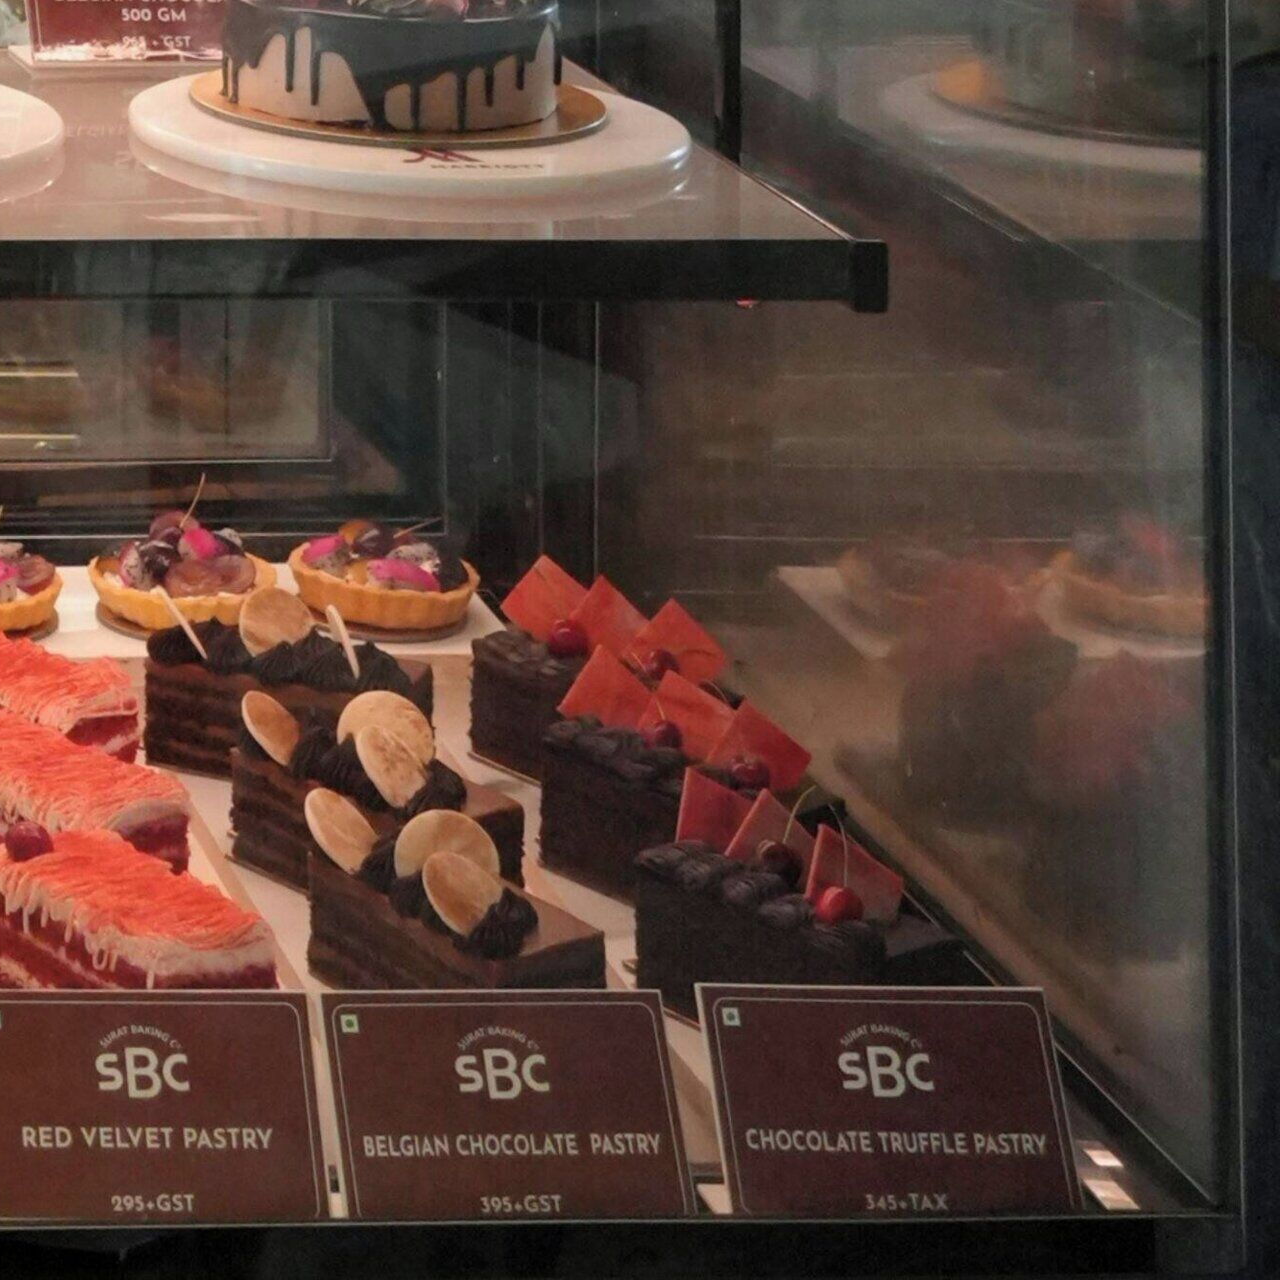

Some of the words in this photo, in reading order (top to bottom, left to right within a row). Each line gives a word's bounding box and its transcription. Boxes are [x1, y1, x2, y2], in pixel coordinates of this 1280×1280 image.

[121, 8, 152, 22] 500
[158, 8, 187, 22] GM
[163, 35, 191, 48] GST
[100, 1025, 129, 1048] SURAT
[131, 1024, 170, 1042] BAKING
[95, 1047, 190, 1099] SBC
[454, 1048, 550, 1100] SBC
[838, 1045, 935, 1098] SBC
[22, 1126, 72, 1149] RED
[80, 1126, 173, 1149] VELVET
[184, 1127, 273, 1150] PASTRY
[363, 1134, 450, 1158] BELGIAN
[456, 1133, 579, 1157] CHOCOLATE
[590, 1132, 660, 1155] PASTRY
[746, 1128, 873, 1153] CHOCOLATE
[878, 1130, 968, 1154] TRUFFLE
[974, 1132, 1046, 1156] PASTRY
